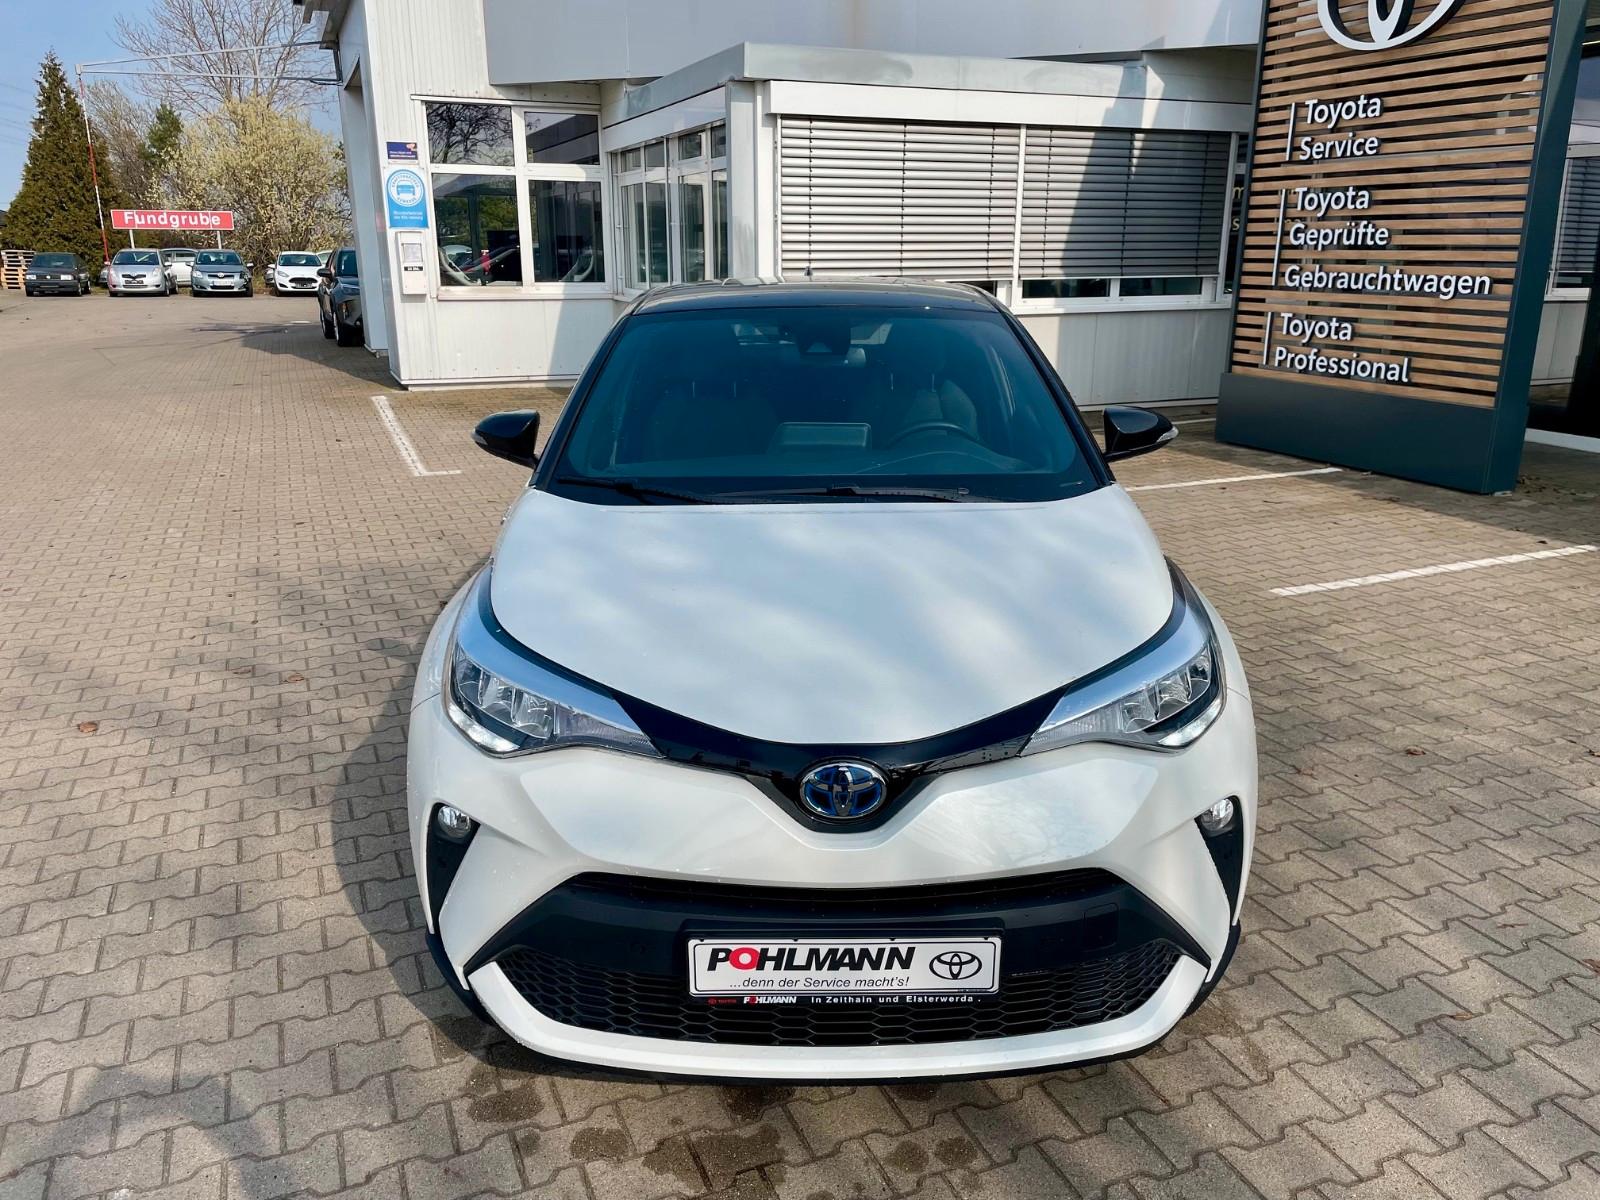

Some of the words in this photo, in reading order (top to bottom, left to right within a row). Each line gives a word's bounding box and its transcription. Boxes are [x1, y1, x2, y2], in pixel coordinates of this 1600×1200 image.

[1305, 95, 1382, 129] Toyota
[1299, 132, 1379, 160] Service
[1294, 187, 1370, 217] Toyota
[123, 211, 221, 228] Fundgrube
[1289, 221, 1389, 250] Geprüfte
[1284, 265, 1491, 299] Gebrauchtwagen
[1281, 313, 1353, 343] Toyota
[1274, 346, 1409, 382] Professional
[707, 946, 916, 971] POHLMANN
[778, 977, 800, 988] der
[803, 976, 850, 988] Service
[855, 976, 910, 987] macht's!
[743, 994, 797, 1005] POHLMANN
[825, 996, 873, 1004] Zeithain
[878, 995, 899, 1003] und
